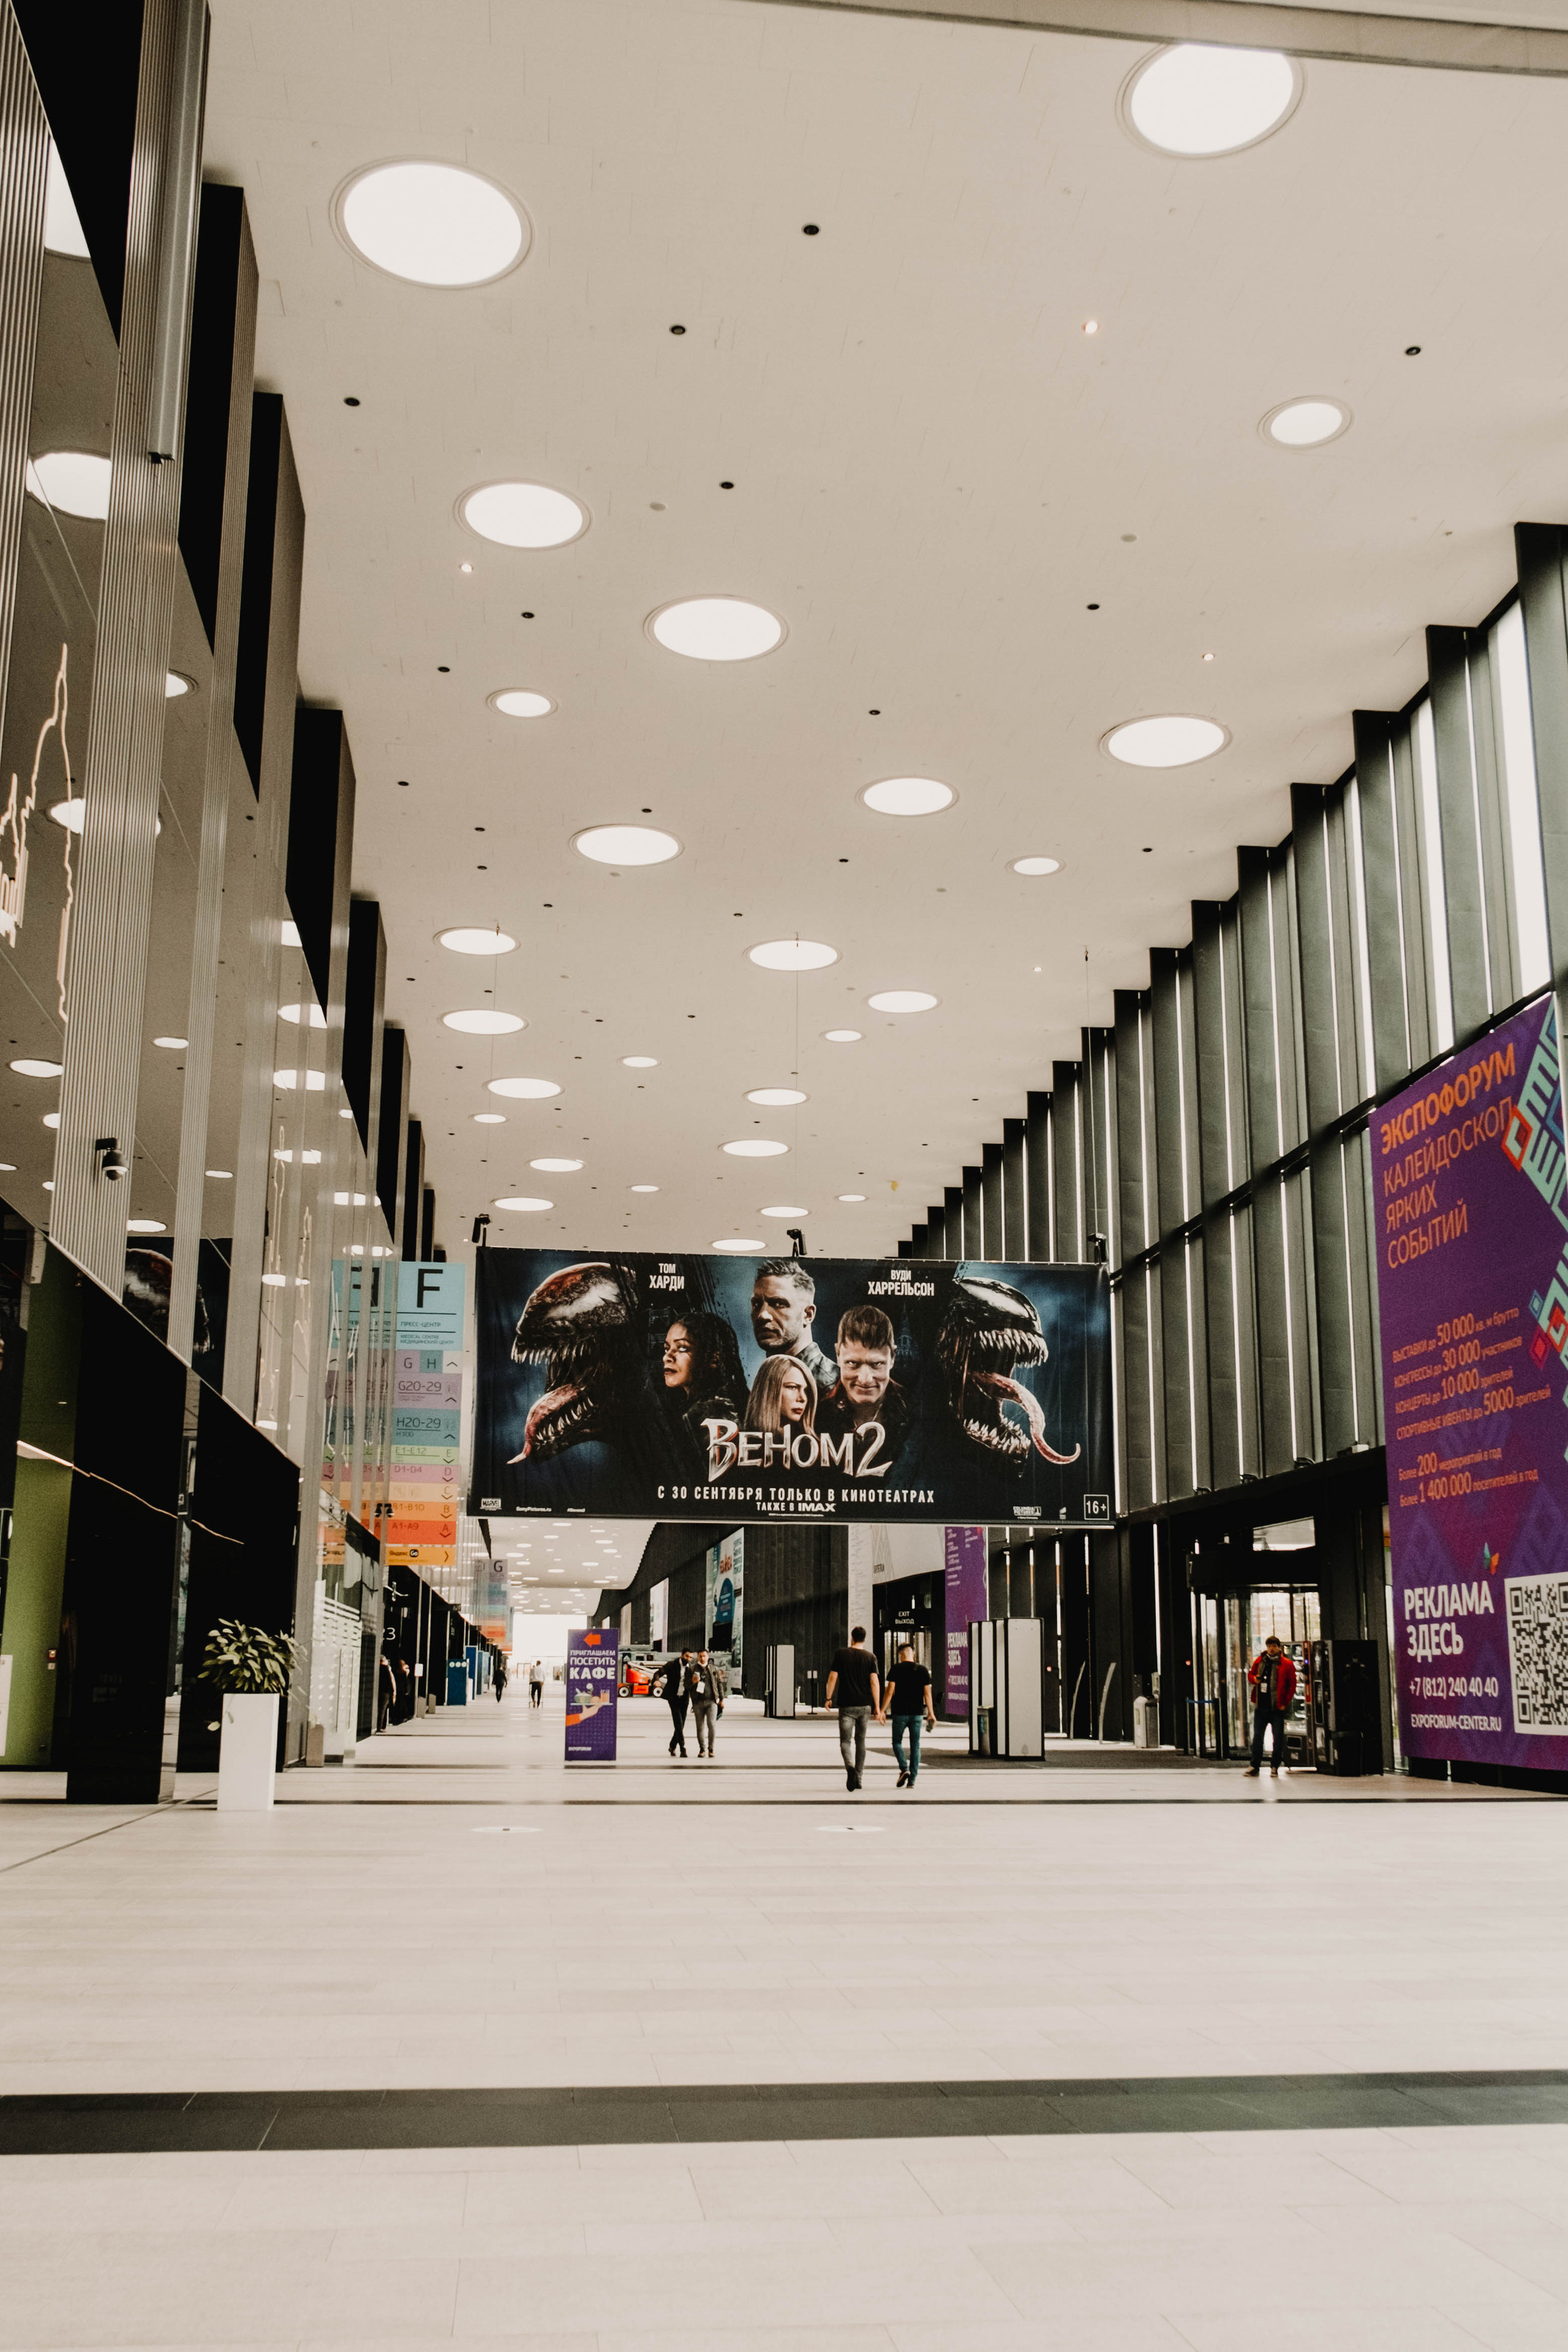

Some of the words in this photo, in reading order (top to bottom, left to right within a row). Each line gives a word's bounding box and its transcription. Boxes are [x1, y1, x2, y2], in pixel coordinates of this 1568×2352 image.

[1381, 1043, 1515, 1154] ЭКСПОФОРУМ
[1384, 1096, 1513, 1196] КАЛЕЙДОСКОП
[1386, 1180, 1437, 1234] ЯРКИХ
[1388, 1199, 1468, 1268] СОБЫТИЙ
[658, 1263, 676, 1273] ТОМ
[891, 1270, 911, 1281] ВУДИ
[417, 1268, 443, 1308] F
[649, 1275, 684, 1291] ХАРДИ
[868, 1282, 935, 1296] ХАРРЕЛЬСОН
[1437, 1322, 1450, 1346] 50
[1452, 1313, 1474, 1341] 000
[404, 1357, 413, 1369] G
[428, 1358, 436, 1369] H
[1442, 1349, 1457, 1371] 30
[1459, 1339, 1480, 1364] 000
[398, 1381, 442, 1392] G20-29
[1442, 1376, 1455, 1399] 10
[1457, 1368, 1479, 1393] 000
[1483, 1386, 1515, 1416] 5000
[396, 1417, 441, 1429] H20-29
[1418, 1452, 1438, 1477] 200
[444, 1487, 451, 1495] C
[658, 1485, 665, 1499] С
[672, 1486, 687, 1499] 30
[695, 1487, 763, 1501] СЕНТЯБРЯ
[769, 1487, 821, 1501] ТОЛЬКО
[827, 1488, 835, 1502] В
[842, 1489, 934, 1503] КИНОТЕАТРАХ
[1419, 1483, 1426, 1504] 1
[1427, 1479, 1448, 1502] 400
[1449, 1472, 1472, 1498] 000
[443, 1505, 450, 1513] B
[756, 1502, 785, 1511] ТАКЖЕ
[789, 1502, 794, 1512] В
[798, 1502, 837, 1512] IMAX
[1086, 1500, 1107, 1514] 16+
[494, 1560, 503, 1572] G
[1404, 1580, 1494, 1620] РЕКЛАМА
[948, 1632, 968, 1648] РЕКЛАМА
[1407, 1622, 1464, 1663] ЗДЕСЬ
[570, 1657, 616, 1665] ПОСЕТИТЬ
[570, 1667, 616, 1680] КАФЕ
[1409, 1678, 1422, 1696] +7
[1423, 1676, 1447, 1700] (812)
[1449, 1677, 1468, 1697] 240
[1469, 1678, 1483, 1697] 40
[1484, 1678, 1499, 1697] 40
[1411, 1713, 1502, 1732] EXPOFORUM-CENTER.RU
